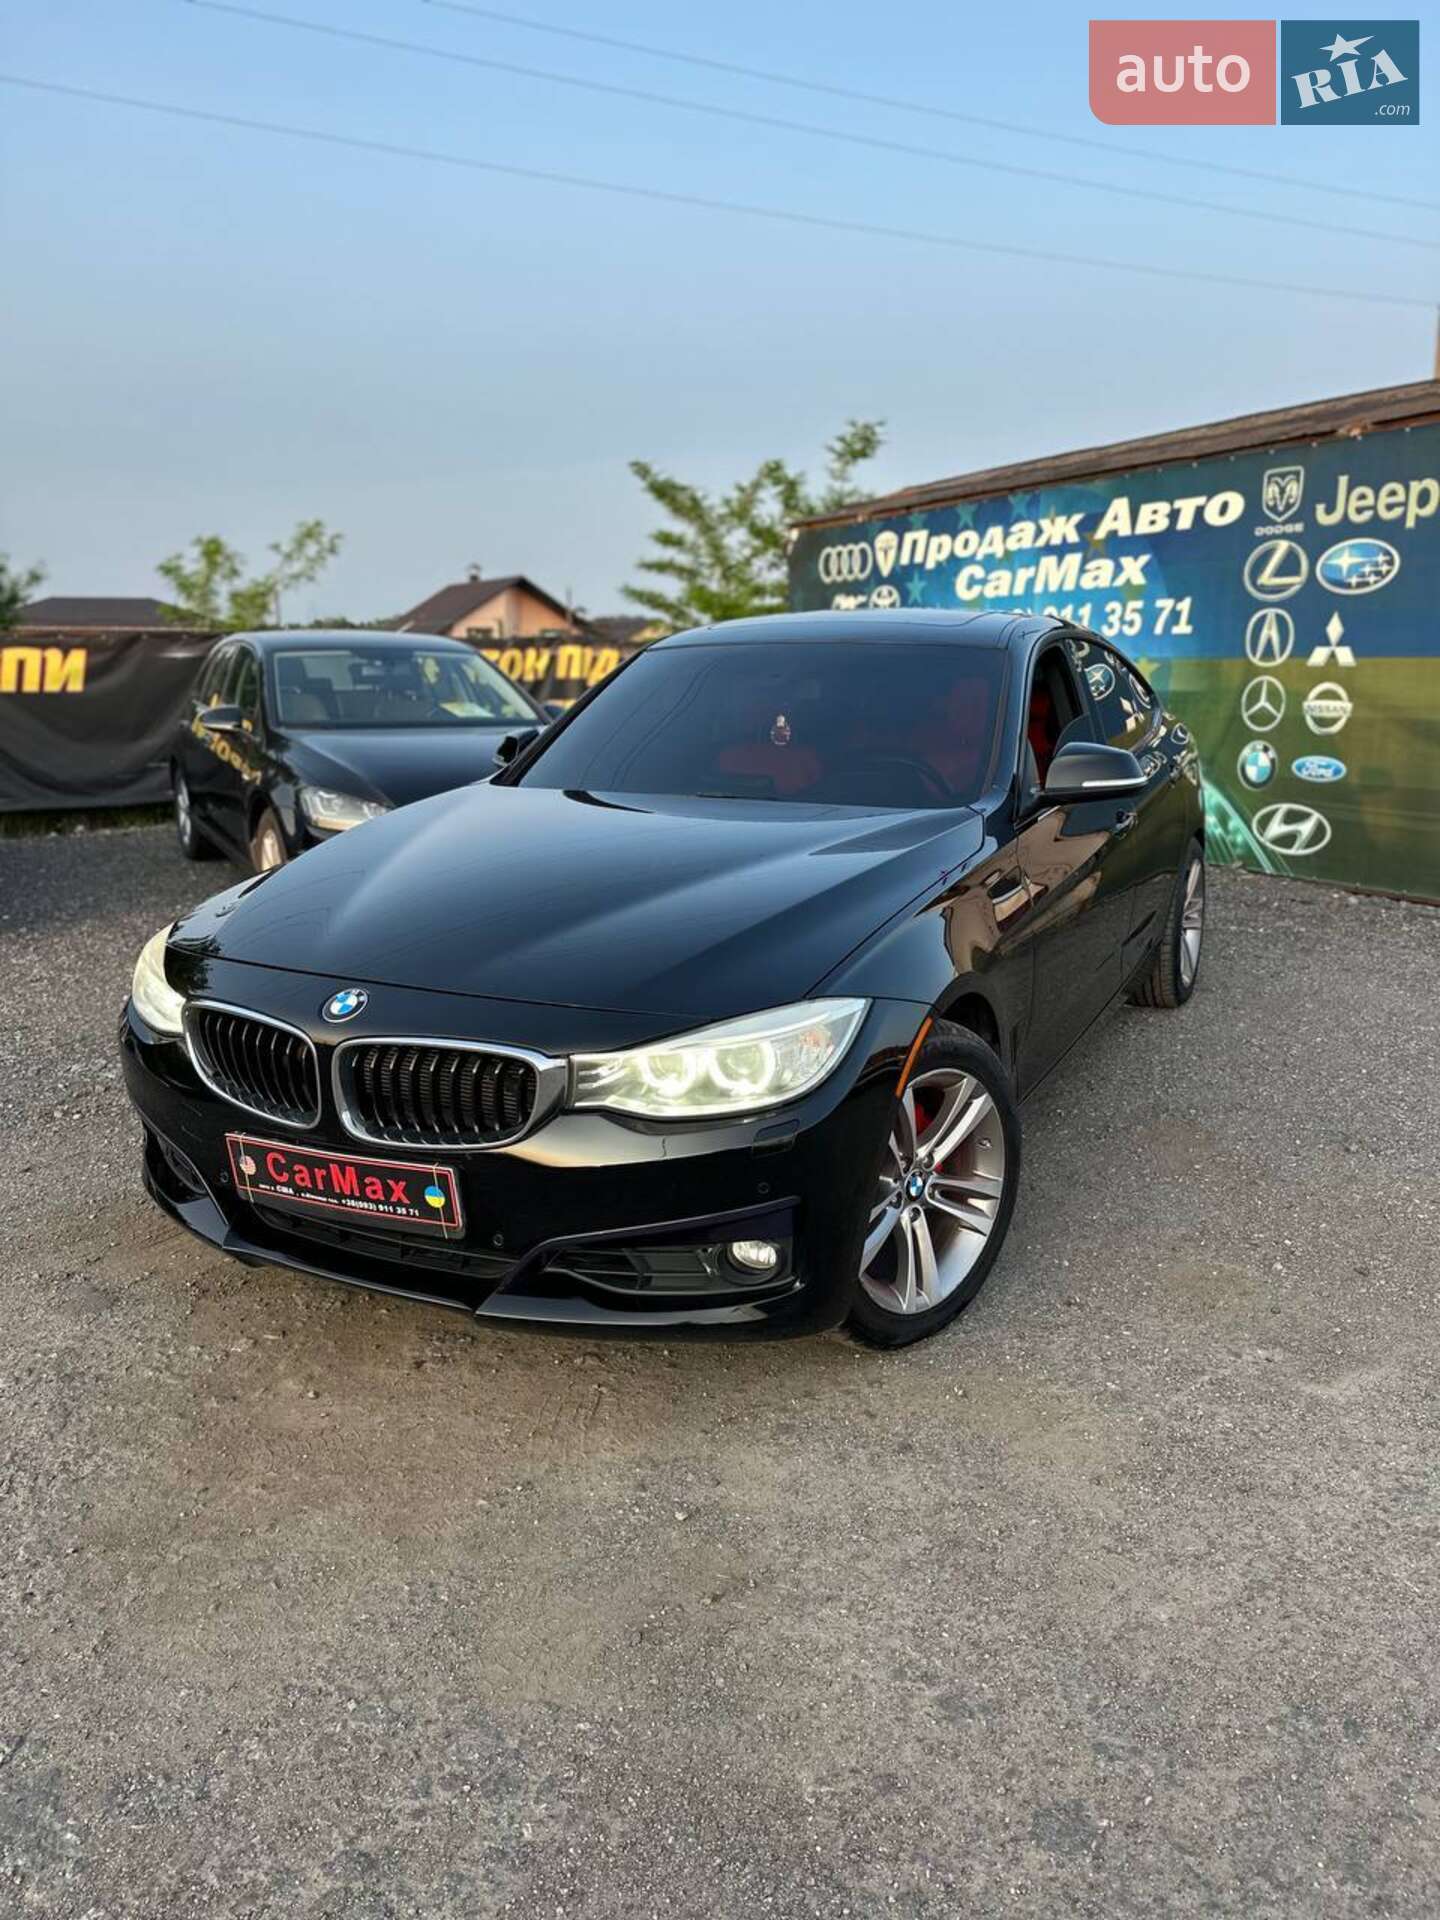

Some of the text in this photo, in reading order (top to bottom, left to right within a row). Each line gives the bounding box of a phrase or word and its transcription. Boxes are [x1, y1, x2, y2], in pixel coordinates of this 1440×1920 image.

[1315, 475, 1440, 529] Jeep
[900, 491, 1245, 569] Продаж Авто
[1254, 523, 1304, 537] DODGE
[955, 553, 1152, 601] CarMax
[1101, 601, 1144, 637] 35
[1154, 596, 1193, 635] 71
[266, 1151, 410, 1204] CarMax
